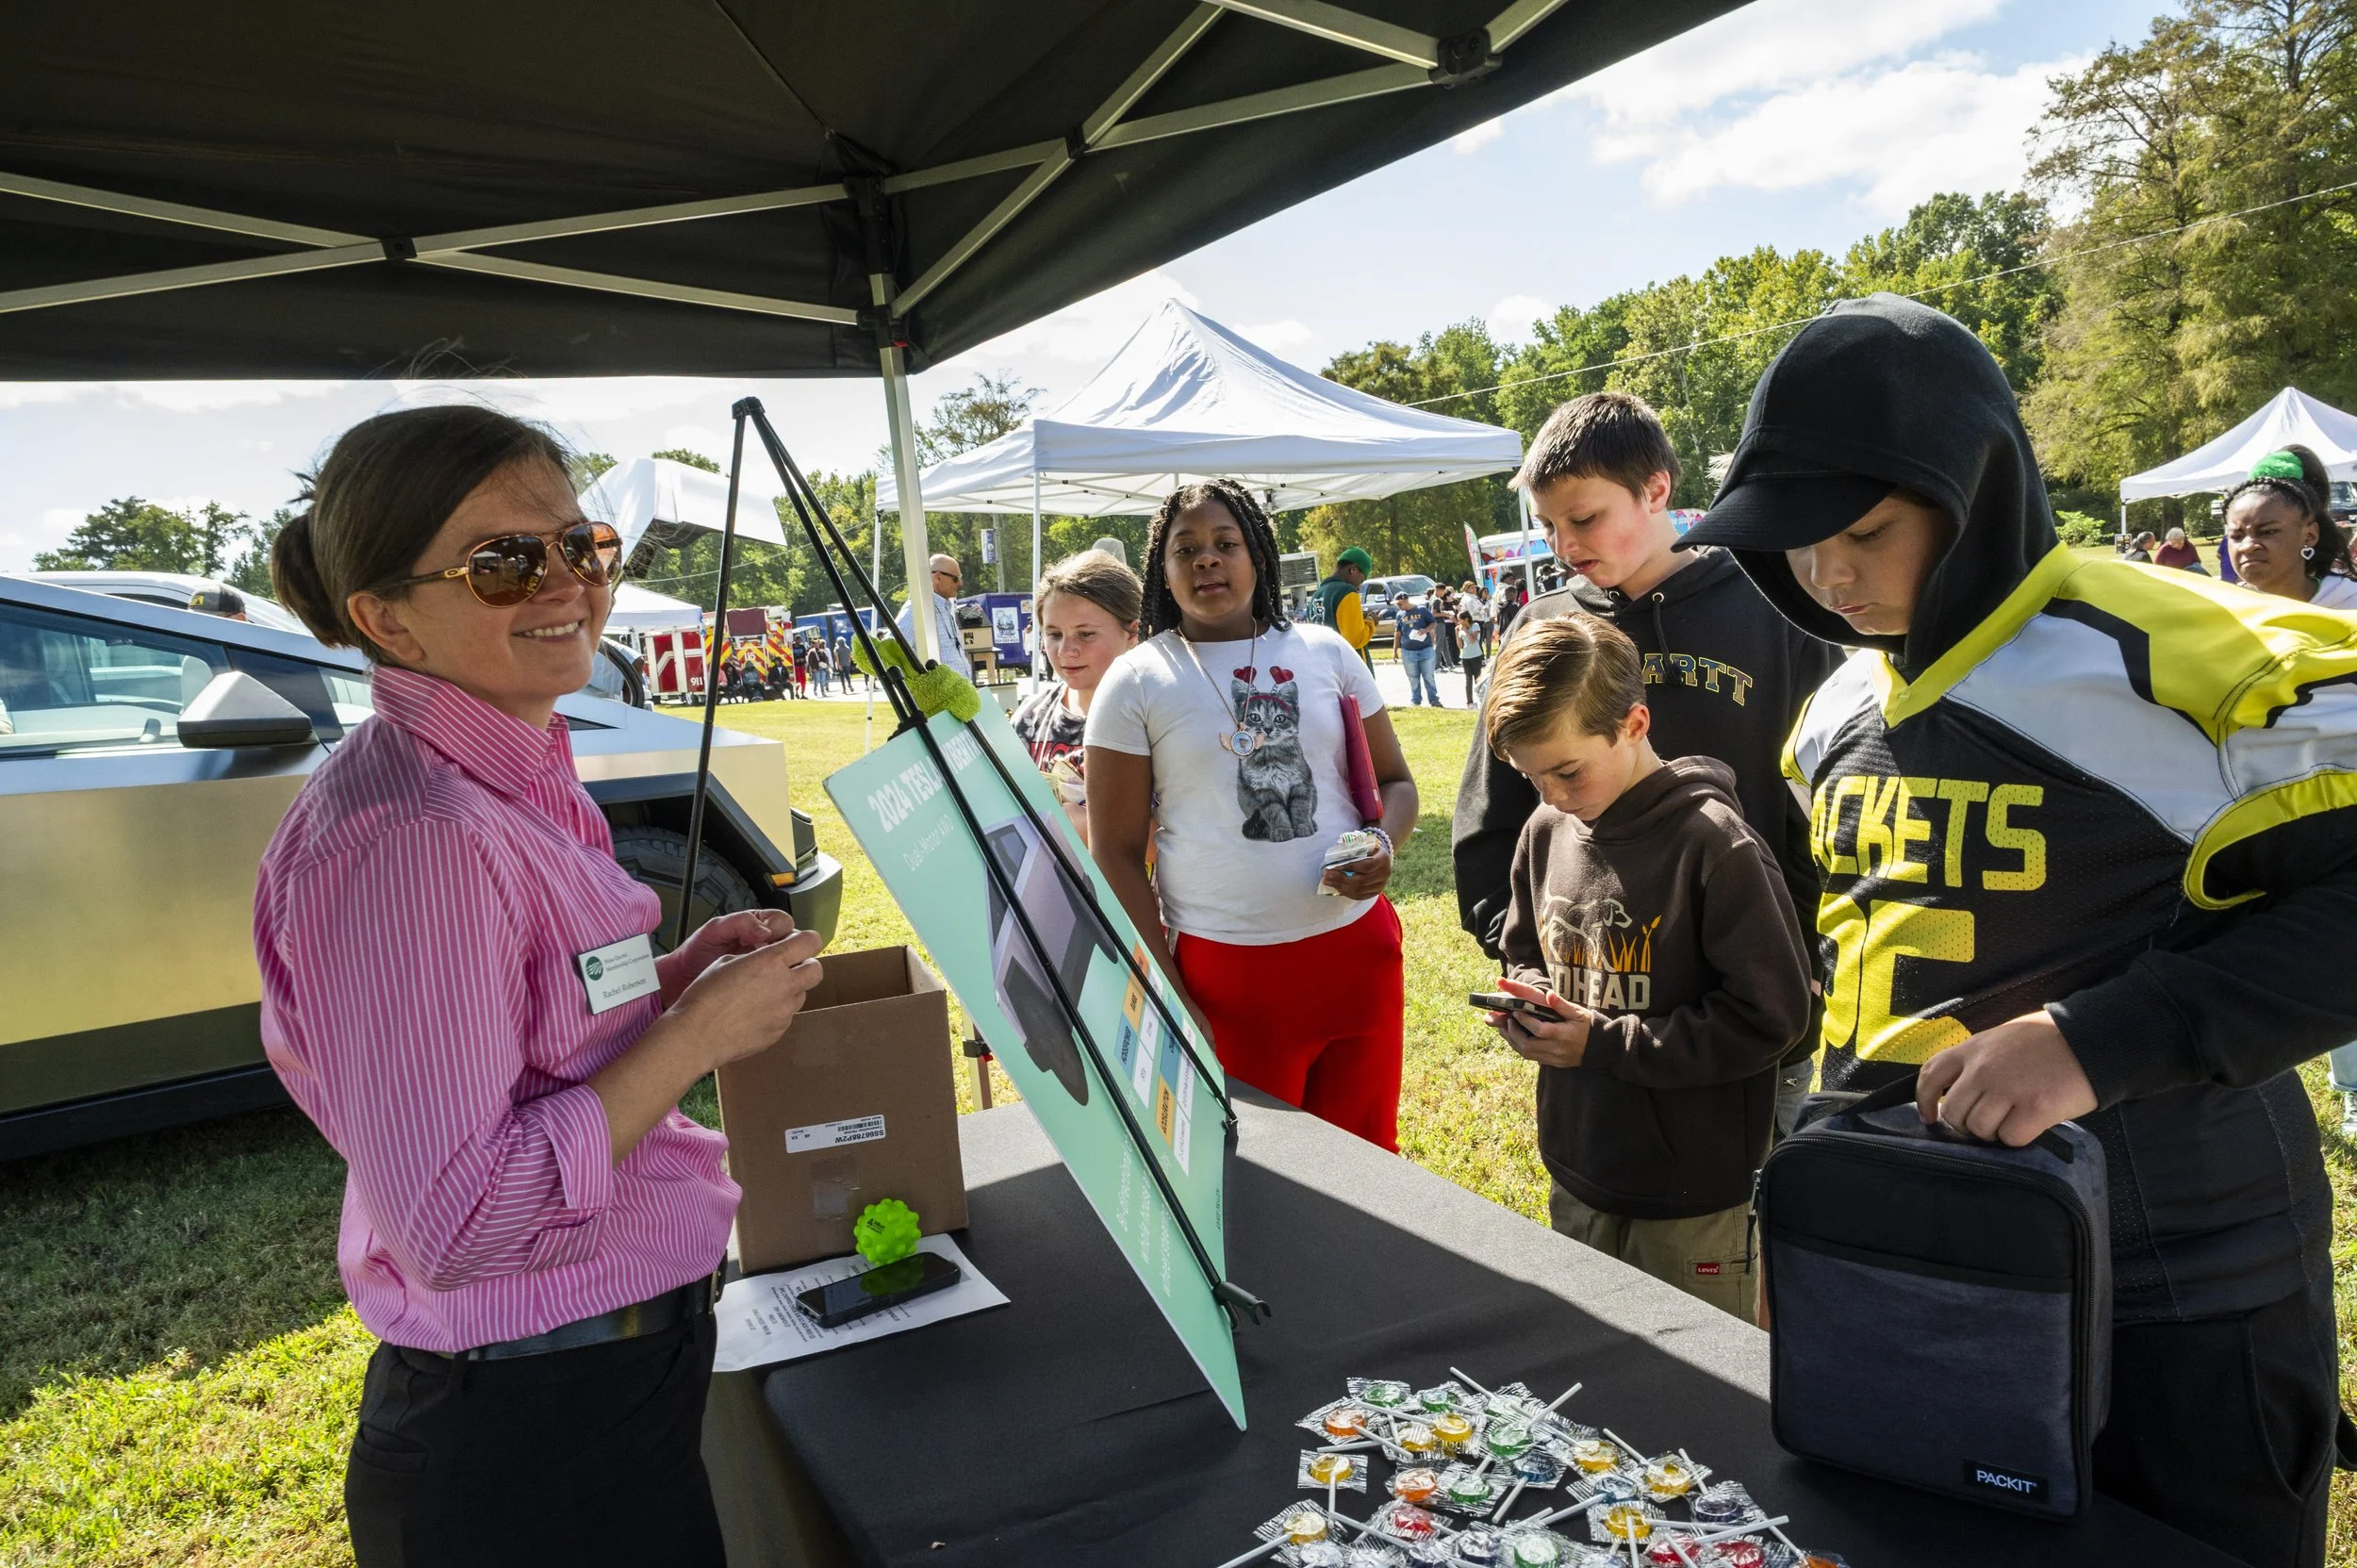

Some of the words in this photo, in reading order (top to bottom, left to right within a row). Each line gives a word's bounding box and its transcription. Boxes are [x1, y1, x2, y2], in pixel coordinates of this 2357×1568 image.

[690, 677, 703, 685] 911
[1641, 653, 1753, 706] ARTT
[867, 779, 915, 834] 2024
[899, 756, 945, 806] TESLA
[902, 826, 944, 872] Dual-Motor
[1809, 775, 2046, 891] ACKETS
[835, 1130, 884, 1143] SS66788P2W
[1976, 1469, 2033, 1494] PACKIT
